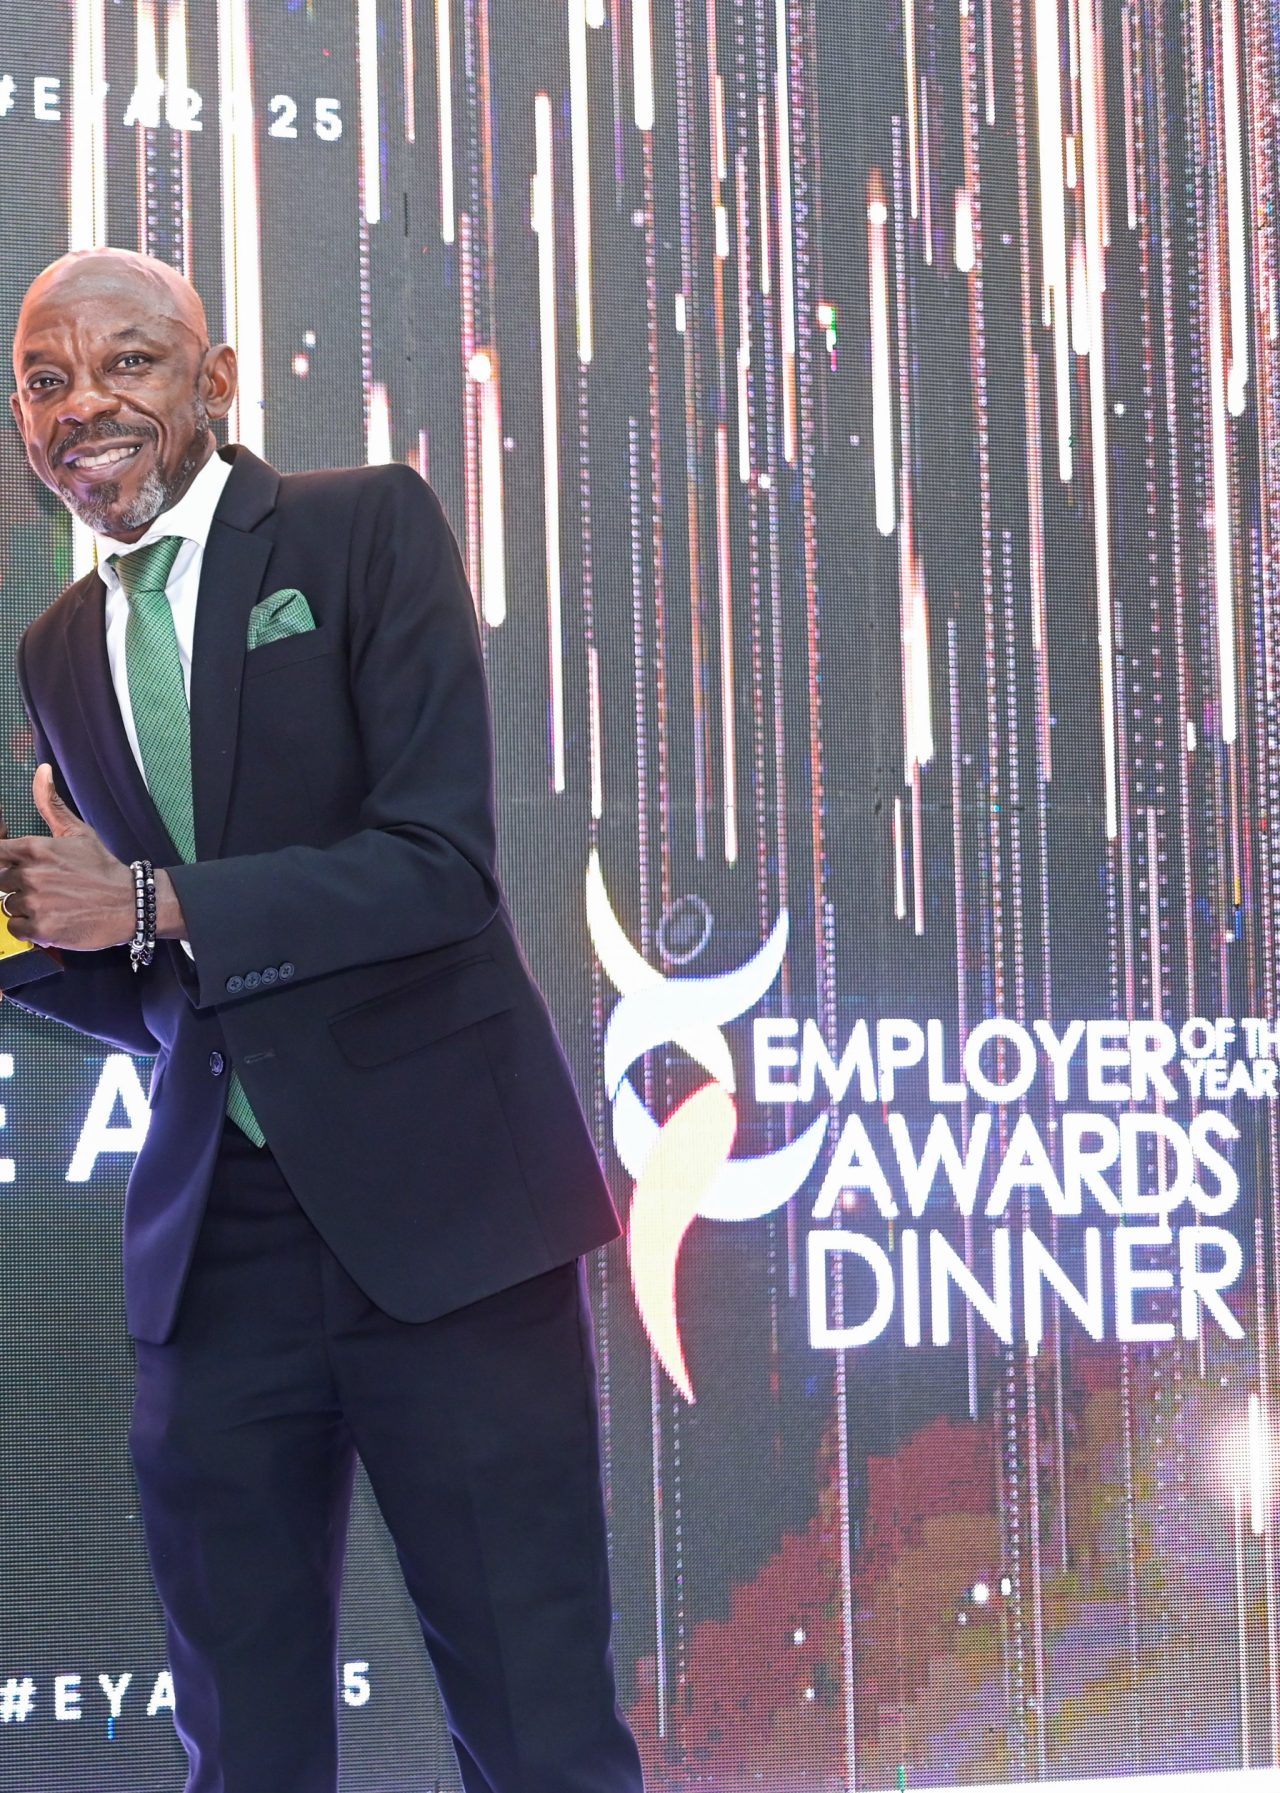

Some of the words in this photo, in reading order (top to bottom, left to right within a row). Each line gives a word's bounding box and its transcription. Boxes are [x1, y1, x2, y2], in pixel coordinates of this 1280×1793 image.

[752, 1017, 1178, 1102] EMPLOYER
[1180, 1016, 1236, 1058] OF
[1241, 1017, 1280, 1058] TH
[1180, 1059, 1280, 1098] YEAR
[811, 1109, 1240, 1218] AWARDS
[806, 1225, 1246, 1350] DINNER
